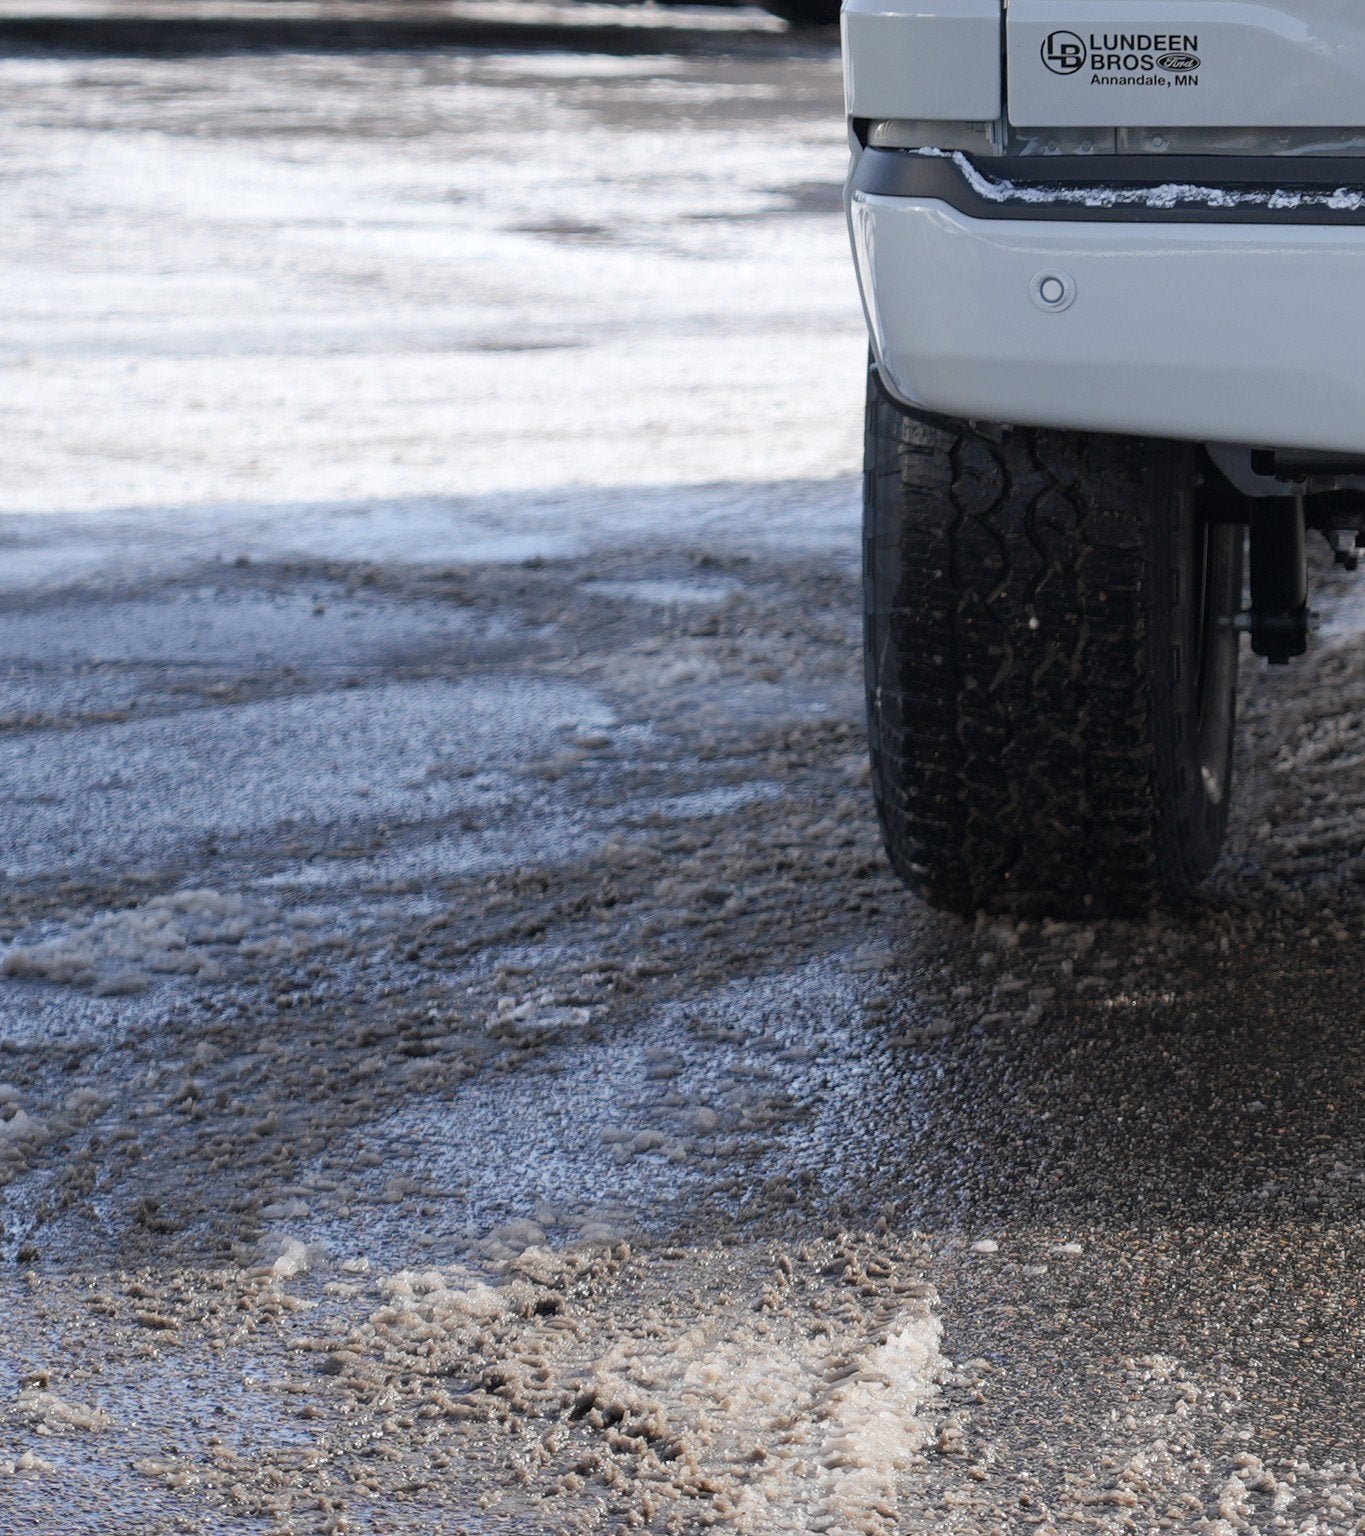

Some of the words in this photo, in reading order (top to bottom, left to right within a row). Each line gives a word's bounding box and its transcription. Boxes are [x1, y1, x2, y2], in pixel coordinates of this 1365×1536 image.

[1090, 34, 1198, 52] LUNDEEN
[1091, 54, 1154, 70] BROS
[1091, 74, 1171, 87] Annandale,
[1175, 76, 1198, 86] MN
